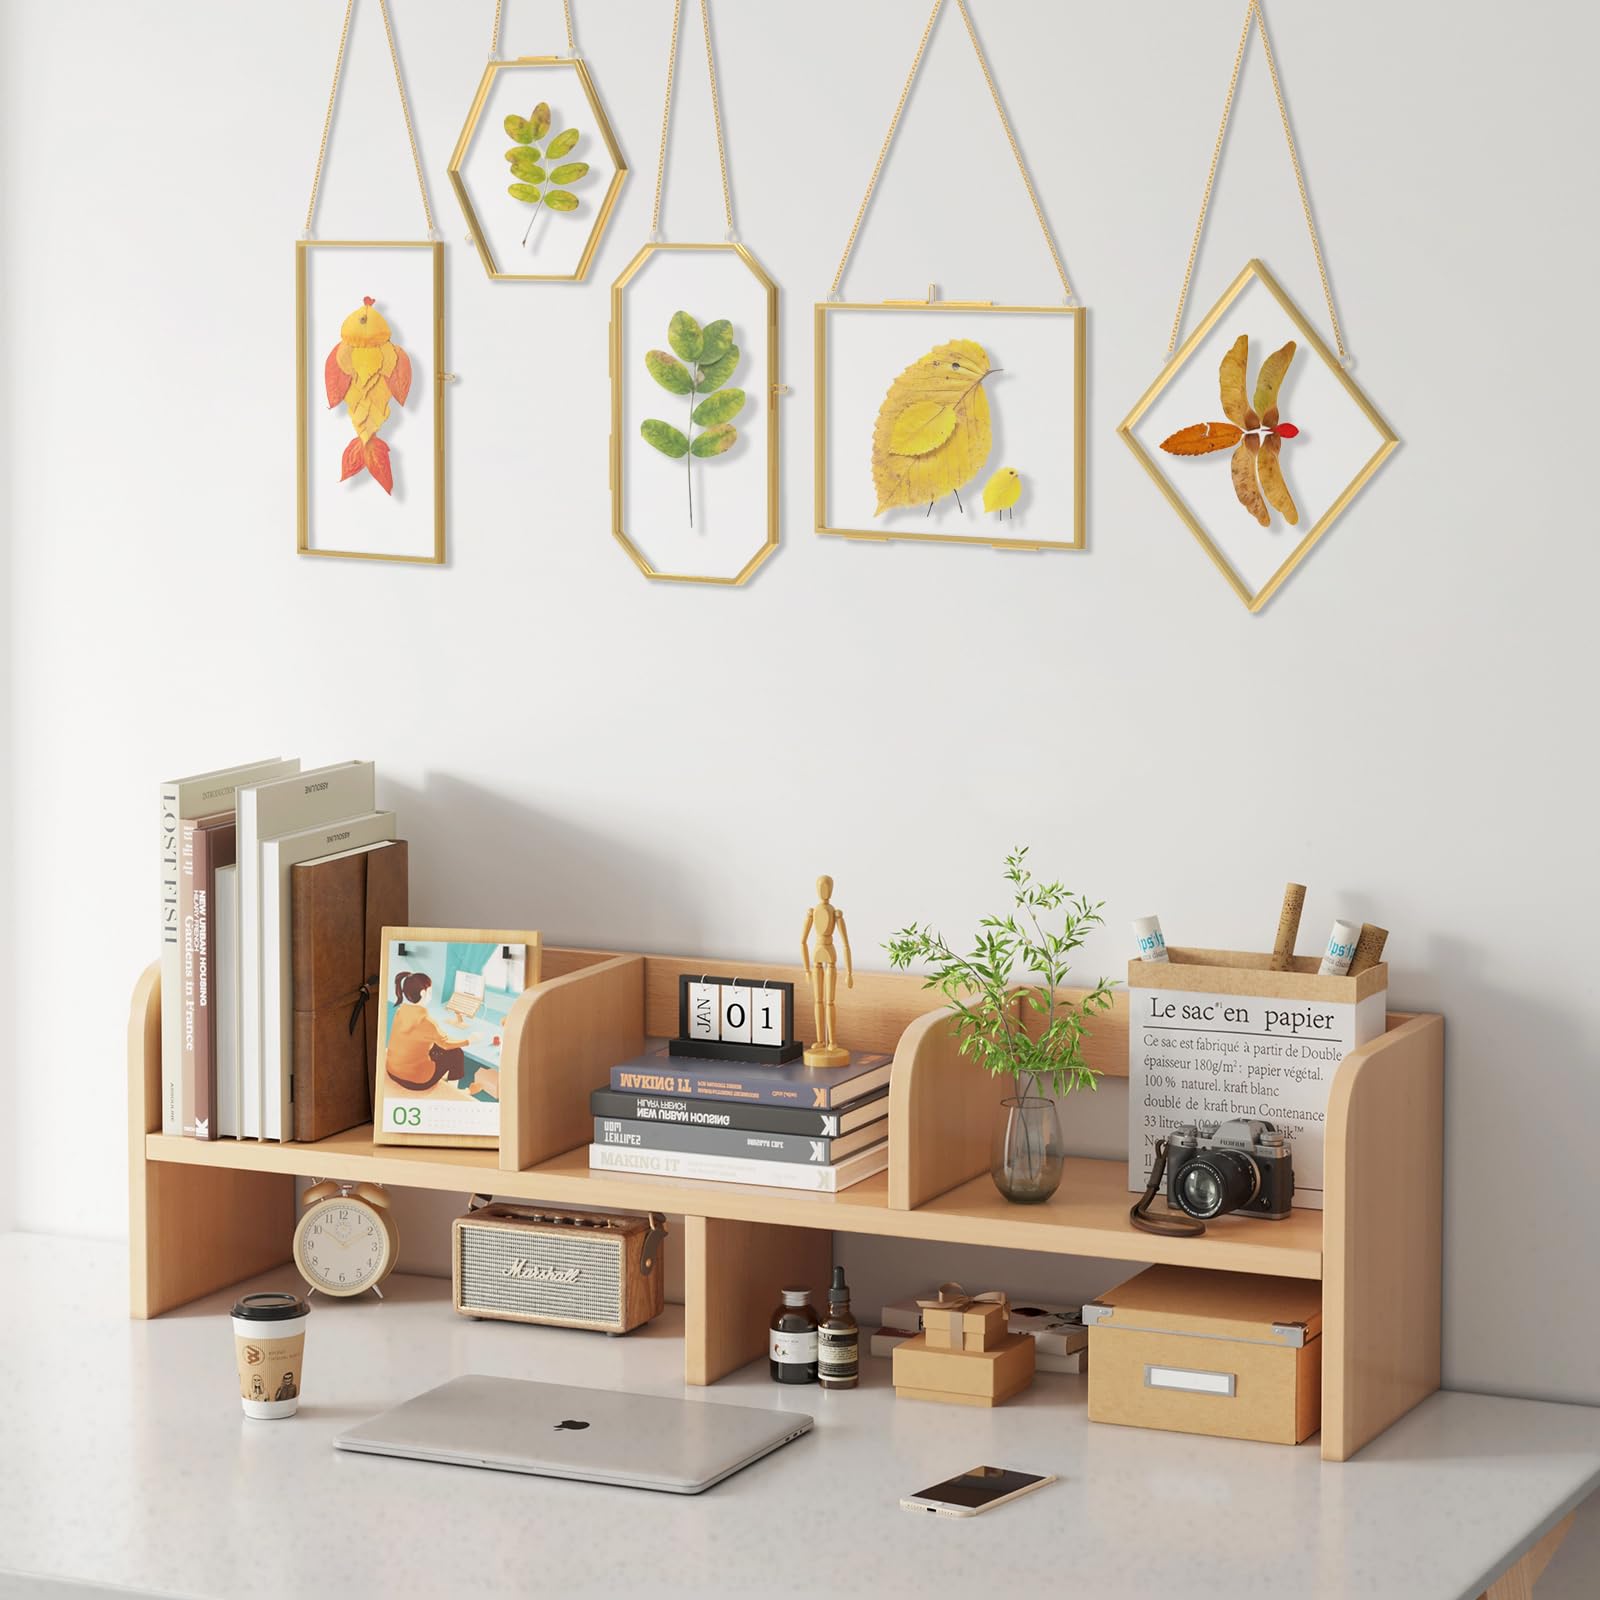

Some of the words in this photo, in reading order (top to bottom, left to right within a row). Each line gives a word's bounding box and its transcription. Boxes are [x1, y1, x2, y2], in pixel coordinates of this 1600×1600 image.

[163, 795, 177, 870] LOST
[164, 880, 177, 943] FISH
[185, 915, 194, 977] Gardens
[185, 980, 194, 996] in
[697, 998, 711, 1033] JAN
[1150, 997, 1176, 1018] Le
[1224, 1007, 1250, 1023] en
[1264, 1007, 1334, 1033] papier
[1144, 1034, 1158, 1046] Ce
[1161, 1038, 1177, 1048] sac
[1180, 1039, 1194, 1049] est
[1196, 1037, 1239, 1056] fabriqué
[1243, 1041, 1250, 1053] à
[1253, 1043, 1282, 1058] partir
[1285, 1044, 1298, 1058] de
[1302, 1045, 1342, 1061] Double
[1144, 1055, 1191, 1070] épaisseur
[1247, 1063, 1281, 1079] papier
[1145, 1074, 1163, 1087] 100
[1223, 1080, 1248, 1094] kraft
[1250, 1082, 1280, 1097] blanc
[393, 1106, 421, 1126] 03
[1144, 1094, 1181, 1109] doublé
[1185, 1096, 1199, 1110] de
[1203, 1097, 1228, 1113] kraft
[1230, 1100, 1256, 1115] brun
[1259, 1104, 1325, 1121] Contenance
[1144, 1115, 1157, 1127] 33
[502, 1258, 580, 1284] Marshall
